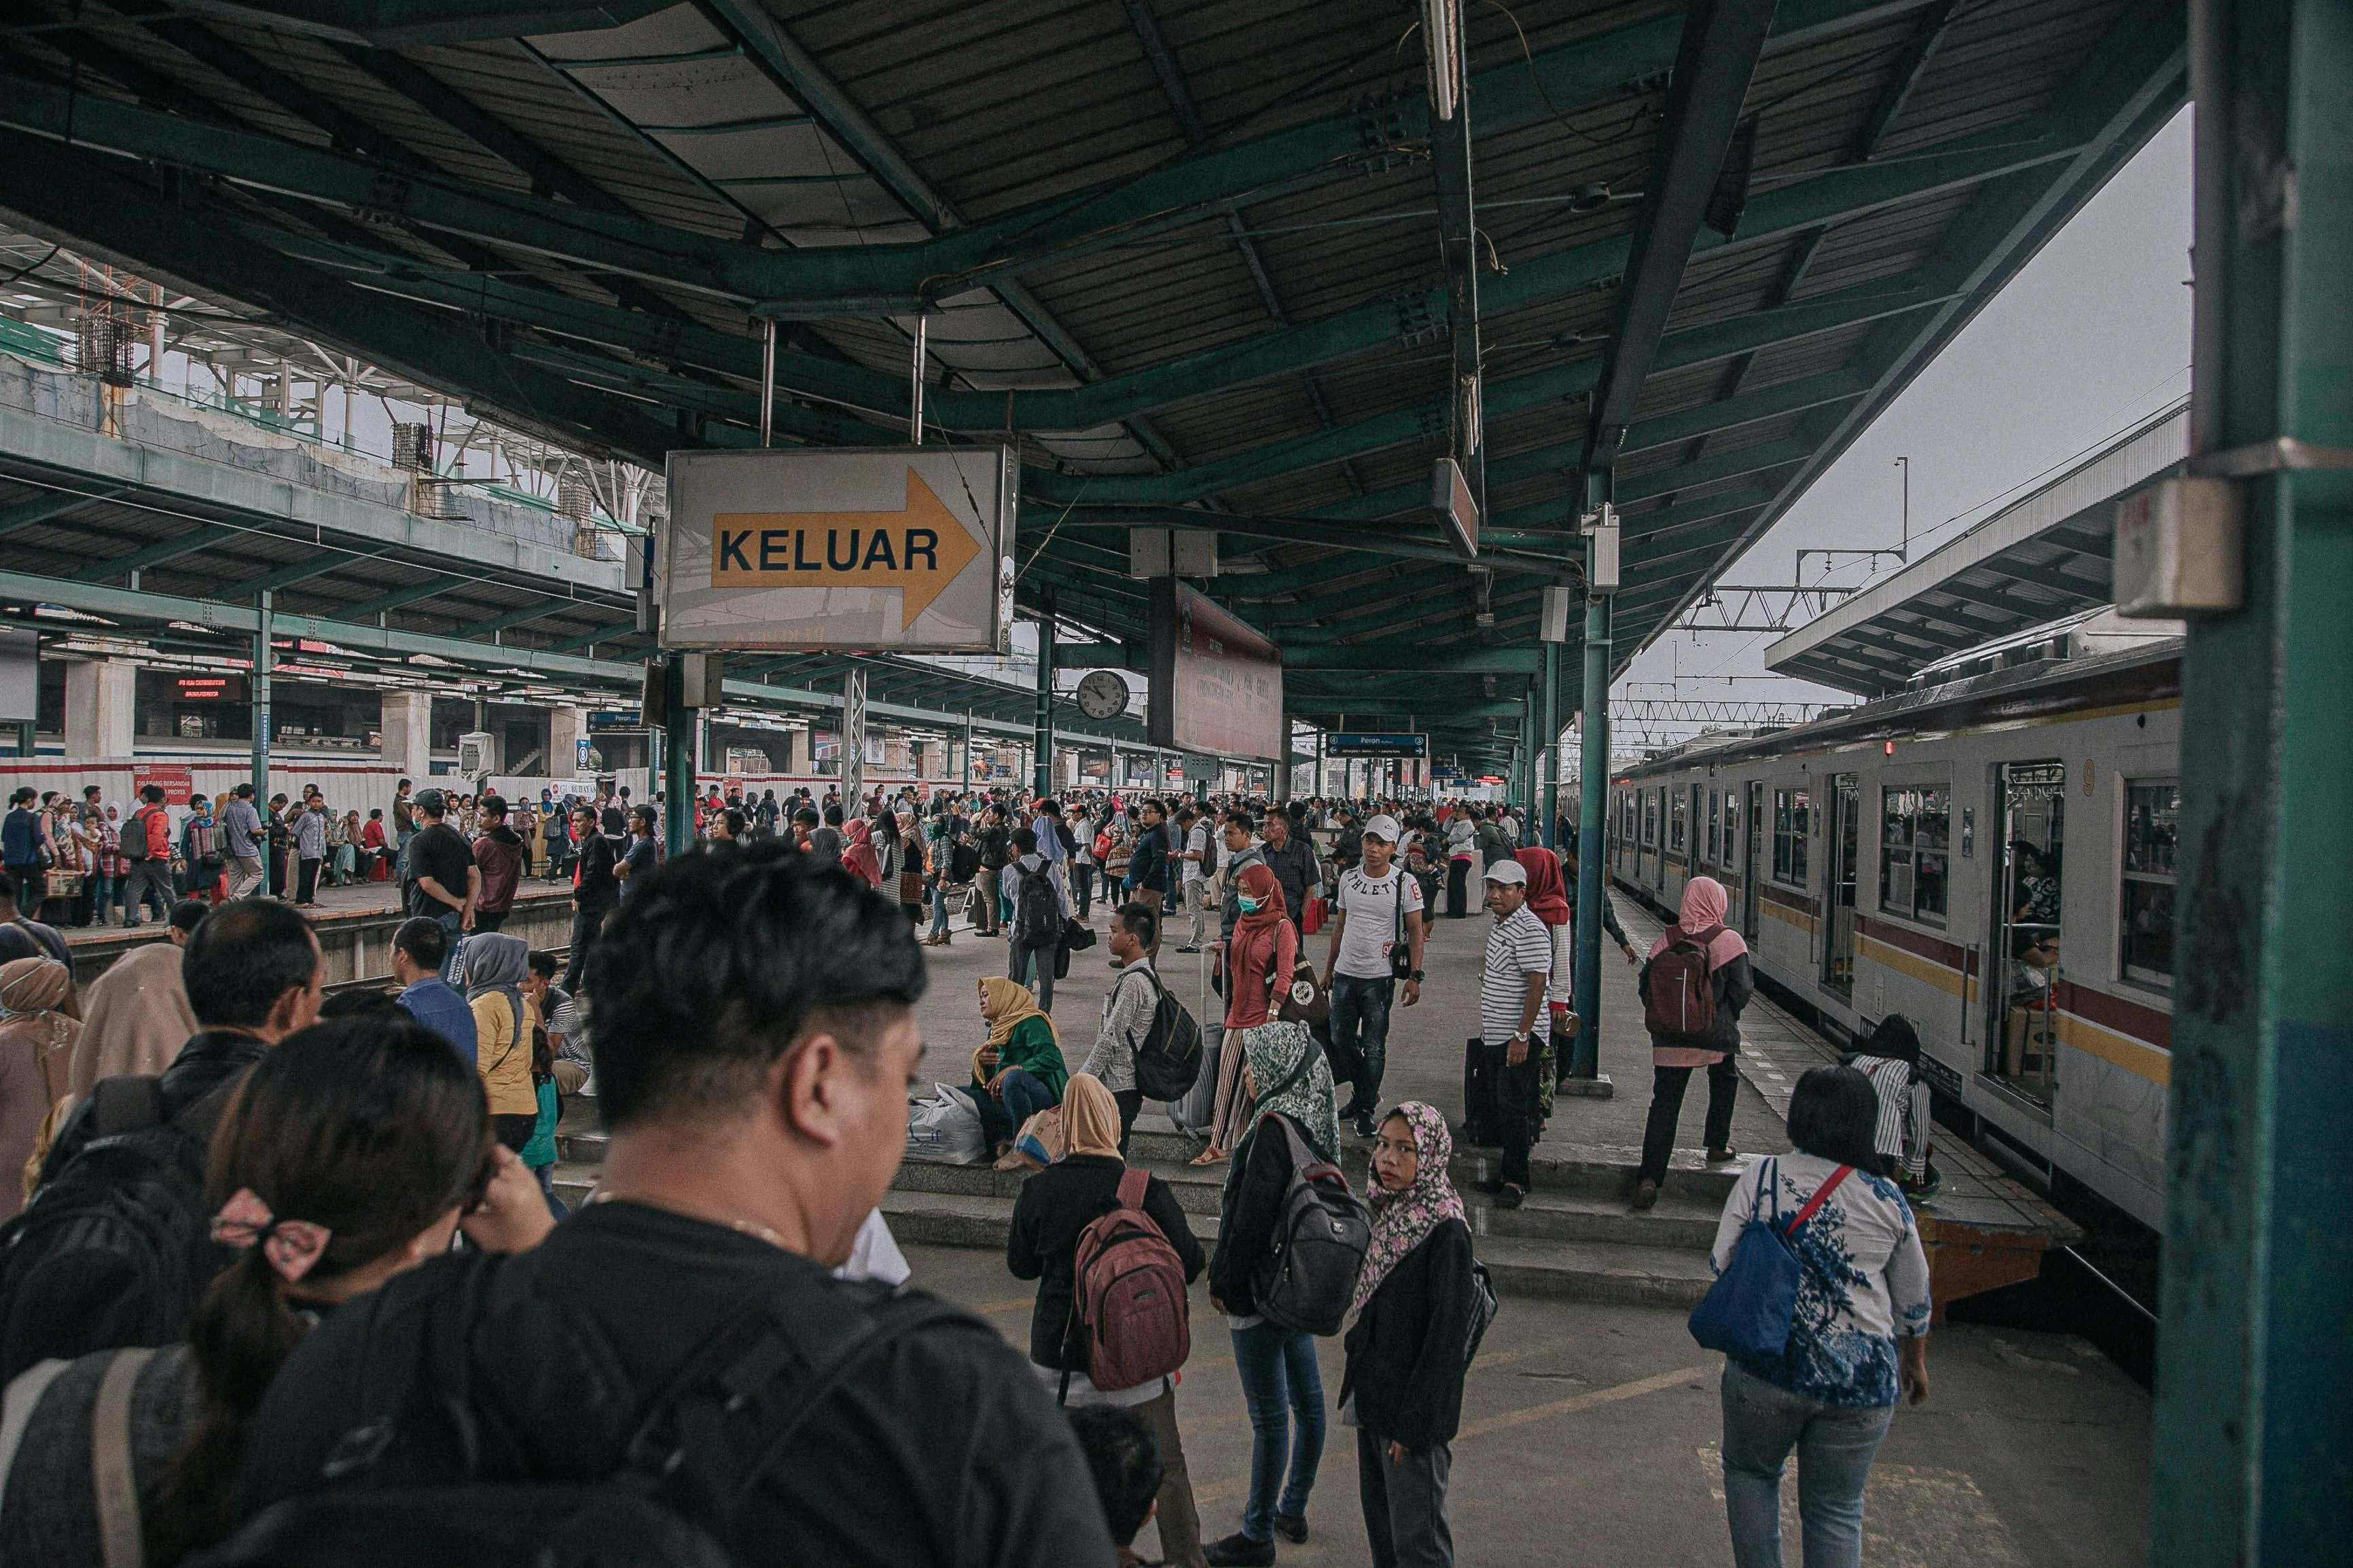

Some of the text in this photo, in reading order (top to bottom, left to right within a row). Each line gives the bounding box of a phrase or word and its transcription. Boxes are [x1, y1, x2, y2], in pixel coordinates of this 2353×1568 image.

[720, 528, 939, 572] KELUAR
[581, 750, 586, 761] 8
[2083, 759, 2095, 797] 9
